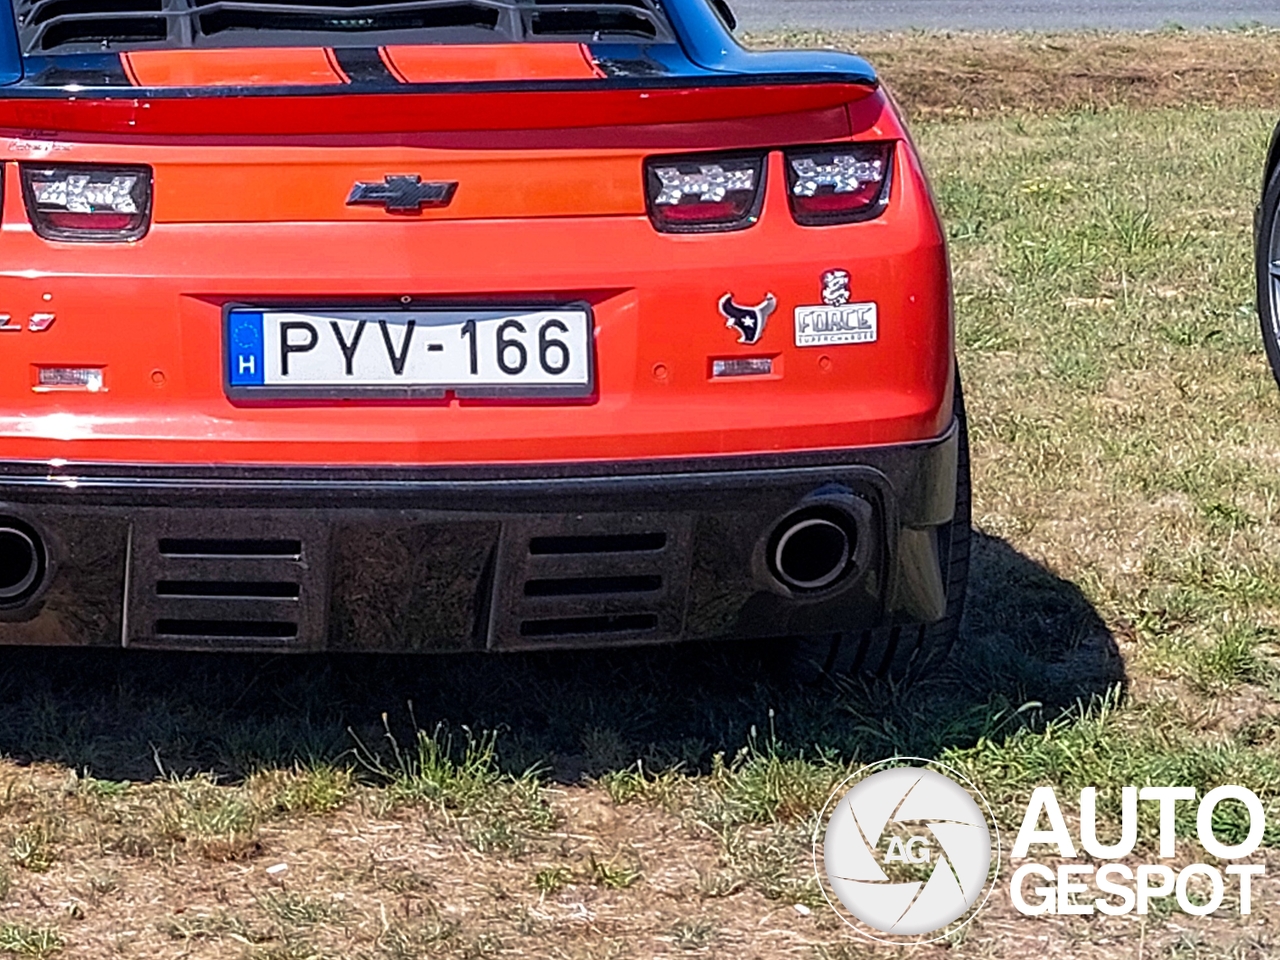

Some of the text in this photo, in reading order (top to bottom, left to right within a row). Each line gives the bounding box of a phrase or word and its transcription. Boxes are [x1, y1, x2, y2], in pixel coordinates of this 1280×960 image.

[798, 307, 873, 333] FORCE
[279, 319, 570, 376] PYV-166
[238, 354, 255, 375] H
